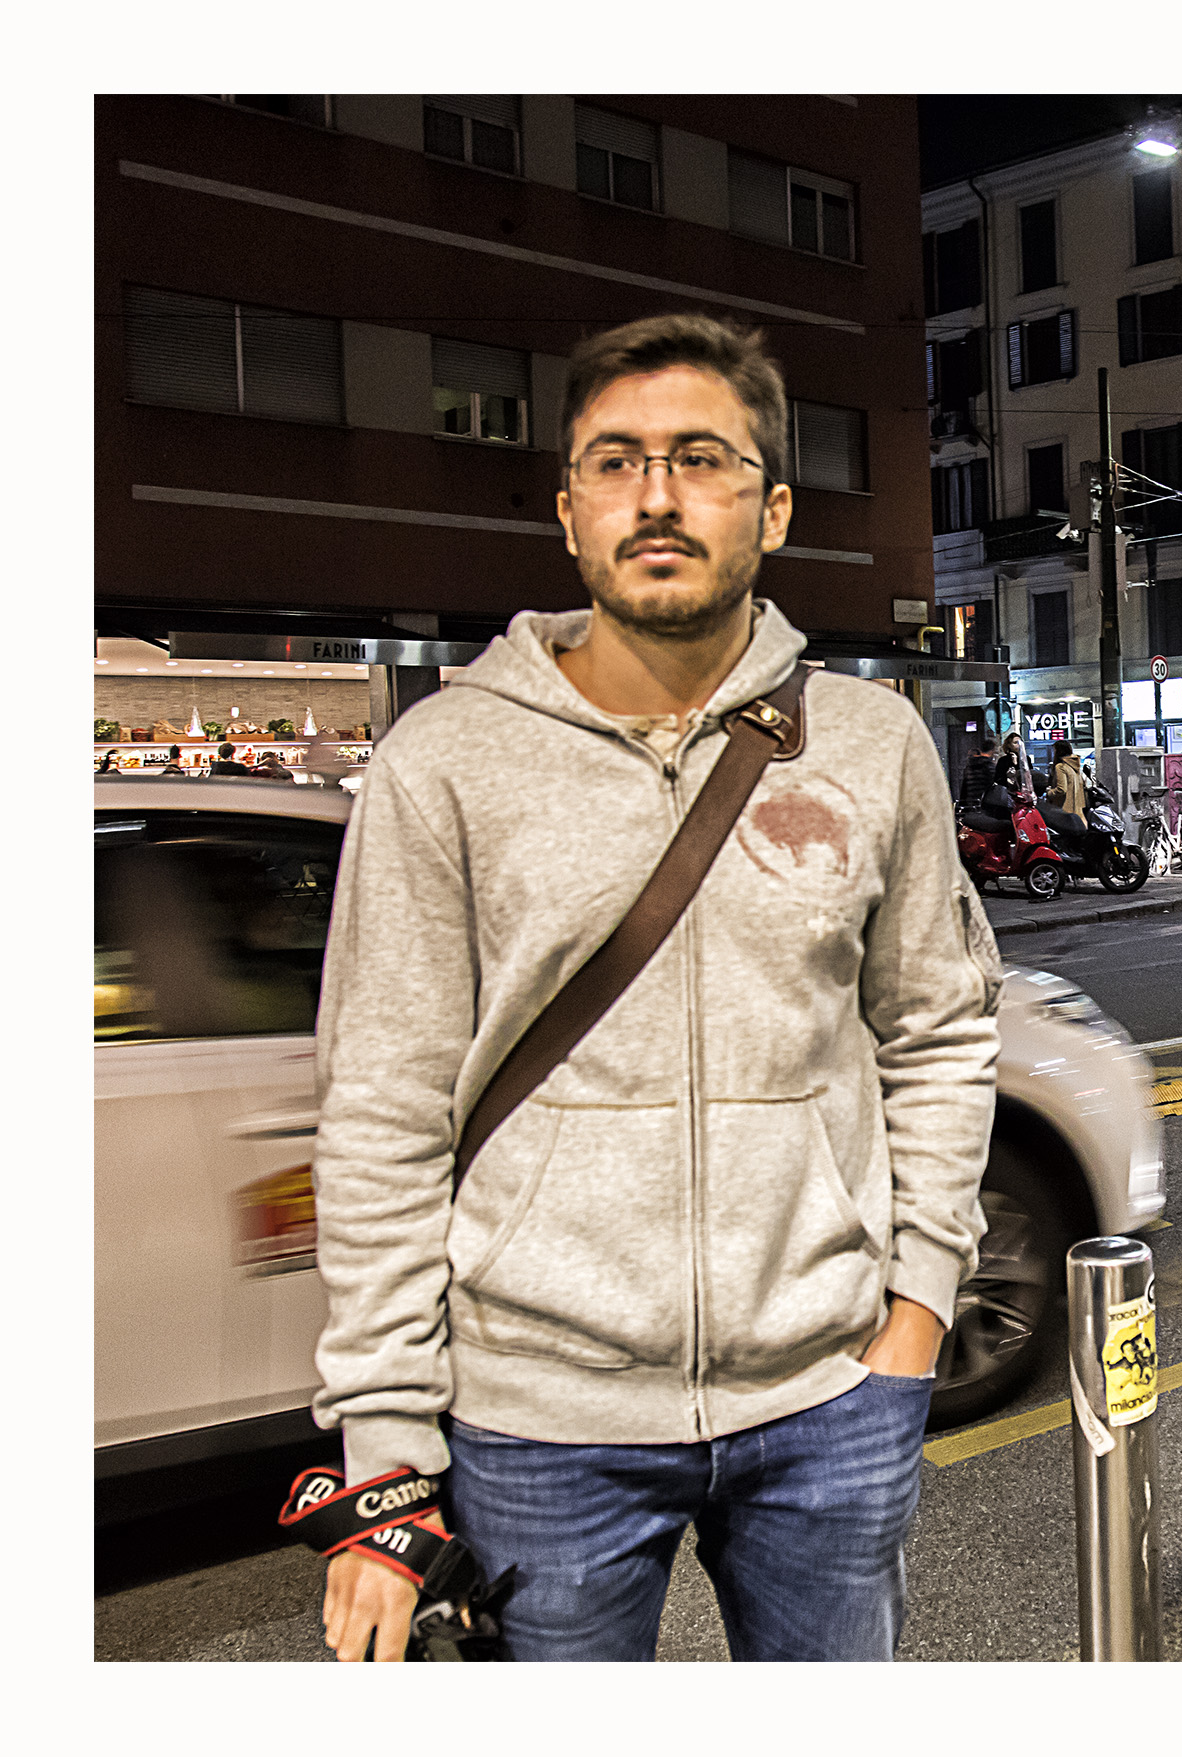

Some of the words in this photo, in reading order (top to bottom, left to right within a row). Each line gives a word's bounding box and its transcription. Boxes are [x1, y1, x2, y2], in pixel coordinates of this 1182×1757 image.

[313, 642, 367, 660] FARINI
[906, 663, 939, 678] FARINI
[1154, 662, 1166, 677] 30
[1025, 711, 1089, 730] YOBE
